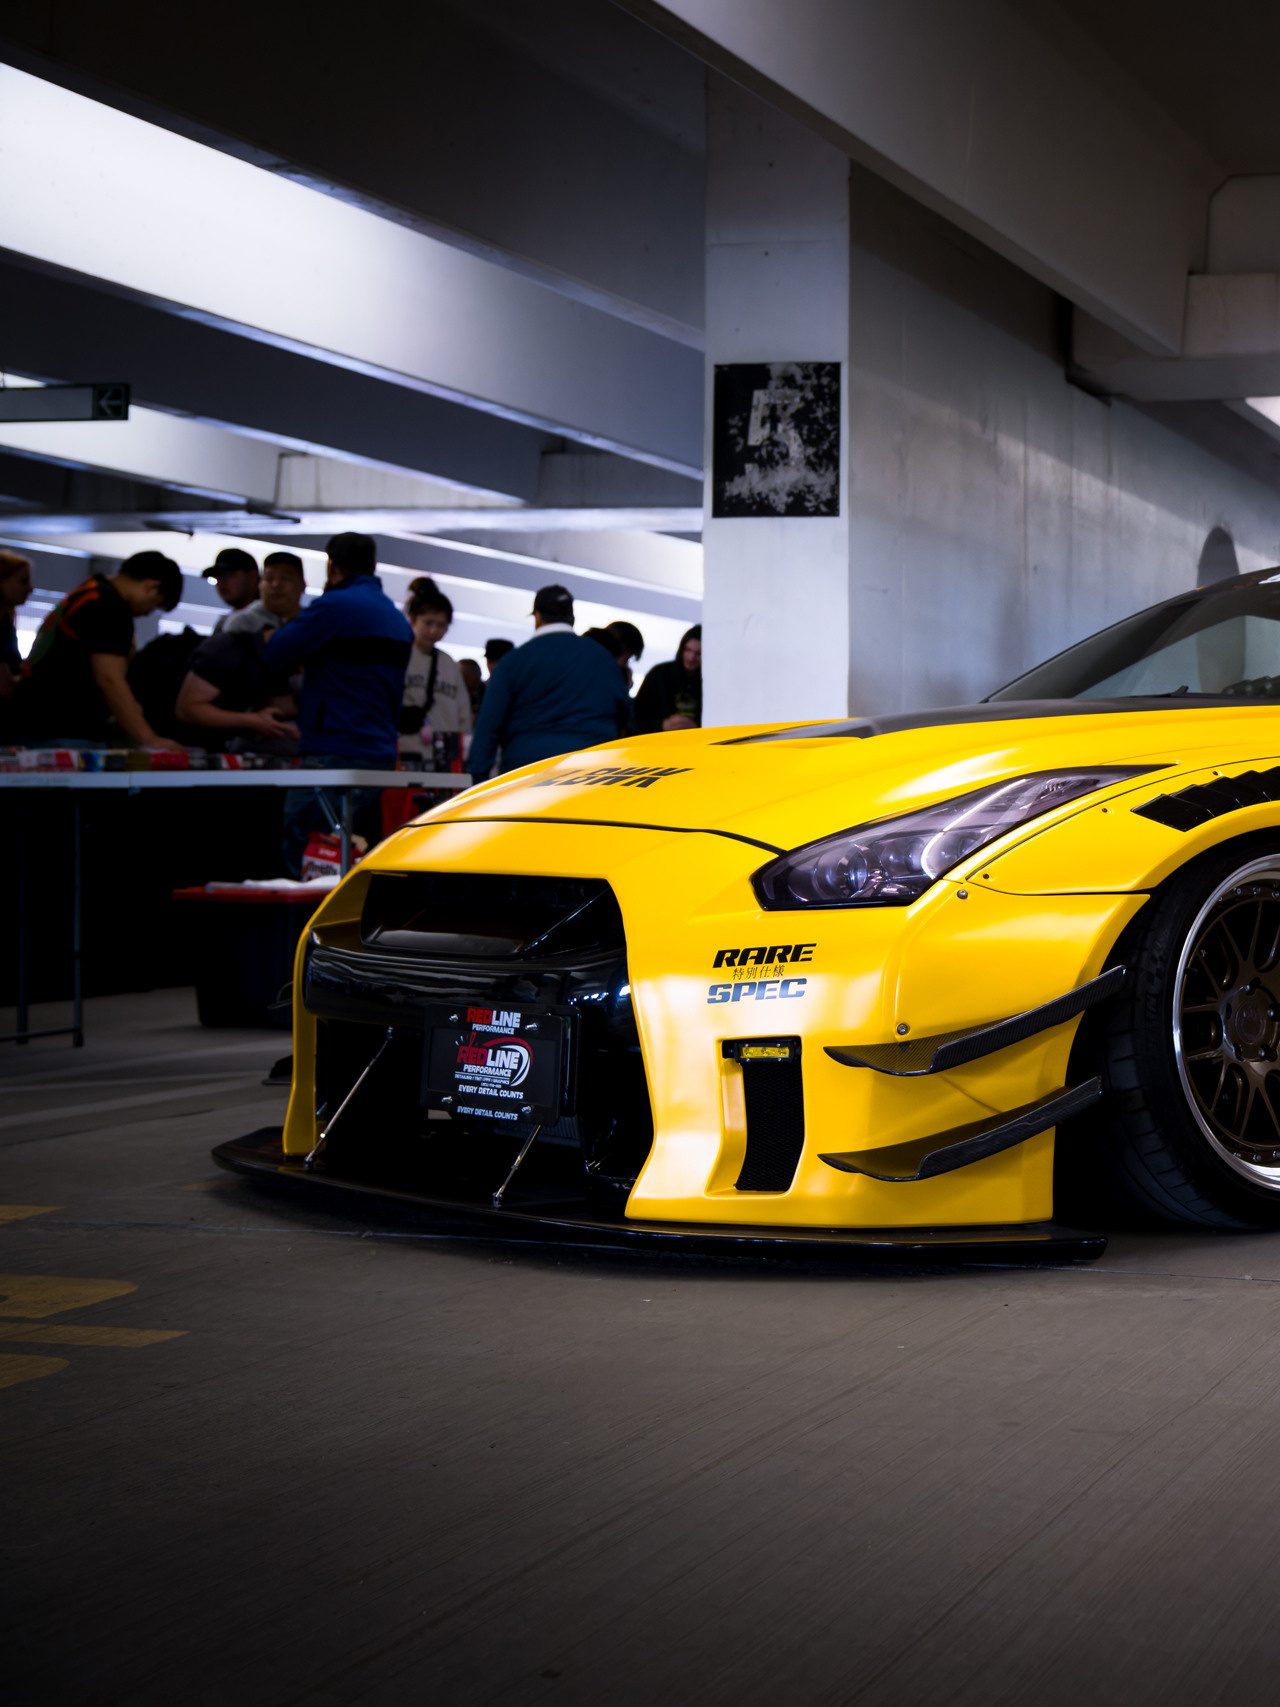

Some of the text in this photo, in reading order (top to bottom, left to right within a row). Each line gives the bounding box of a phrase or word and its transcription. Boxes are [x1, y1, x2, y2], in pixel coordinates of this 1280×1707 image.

[712, 943, 817, 969] RARE
[706, 977, 808, 1004] SPEC
[472, 1023, 515, 1035] PERFORMANCE
[463, 1064, 512, 1077] PERFORMANCE
[458, 1084, 478, 1093] EVERY
[478, 1087, 499, 1096] DETAIL
[499, 1089, 524, 1099] COUNTS
[457, 1105, 518, 1120] EVERY DETAIL COUNTS
